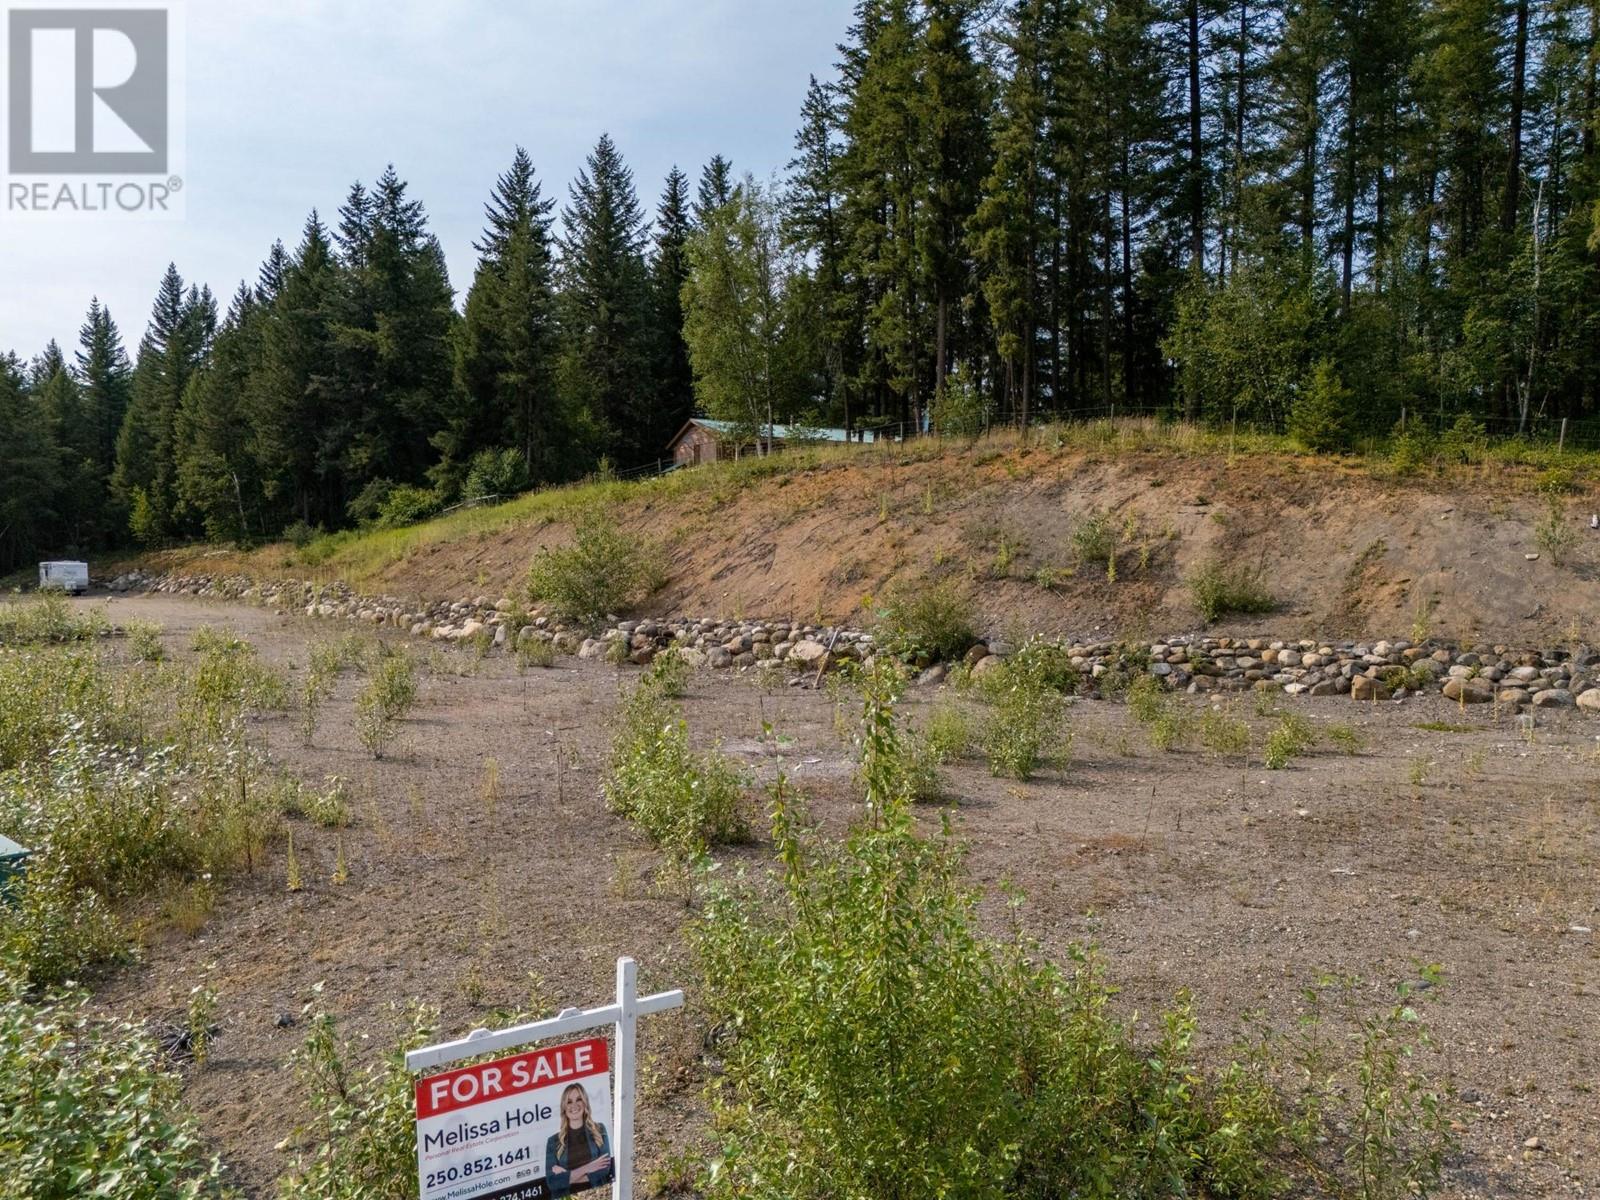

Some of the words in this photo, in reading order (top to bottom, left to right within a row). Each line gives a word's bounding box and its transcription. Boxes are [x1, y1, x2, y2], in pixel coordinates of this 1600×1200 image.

[430, 1067, 504, 1110] FOR
[511, 1045, 594, 1087] SALE
[424, 1119, 500, 1153] Melissa
[505, 1103, 552, 1130] Hole
[424, 1148, 450, 1161] Personal
[426, 1146, 531, 1188] 250.852.1641
